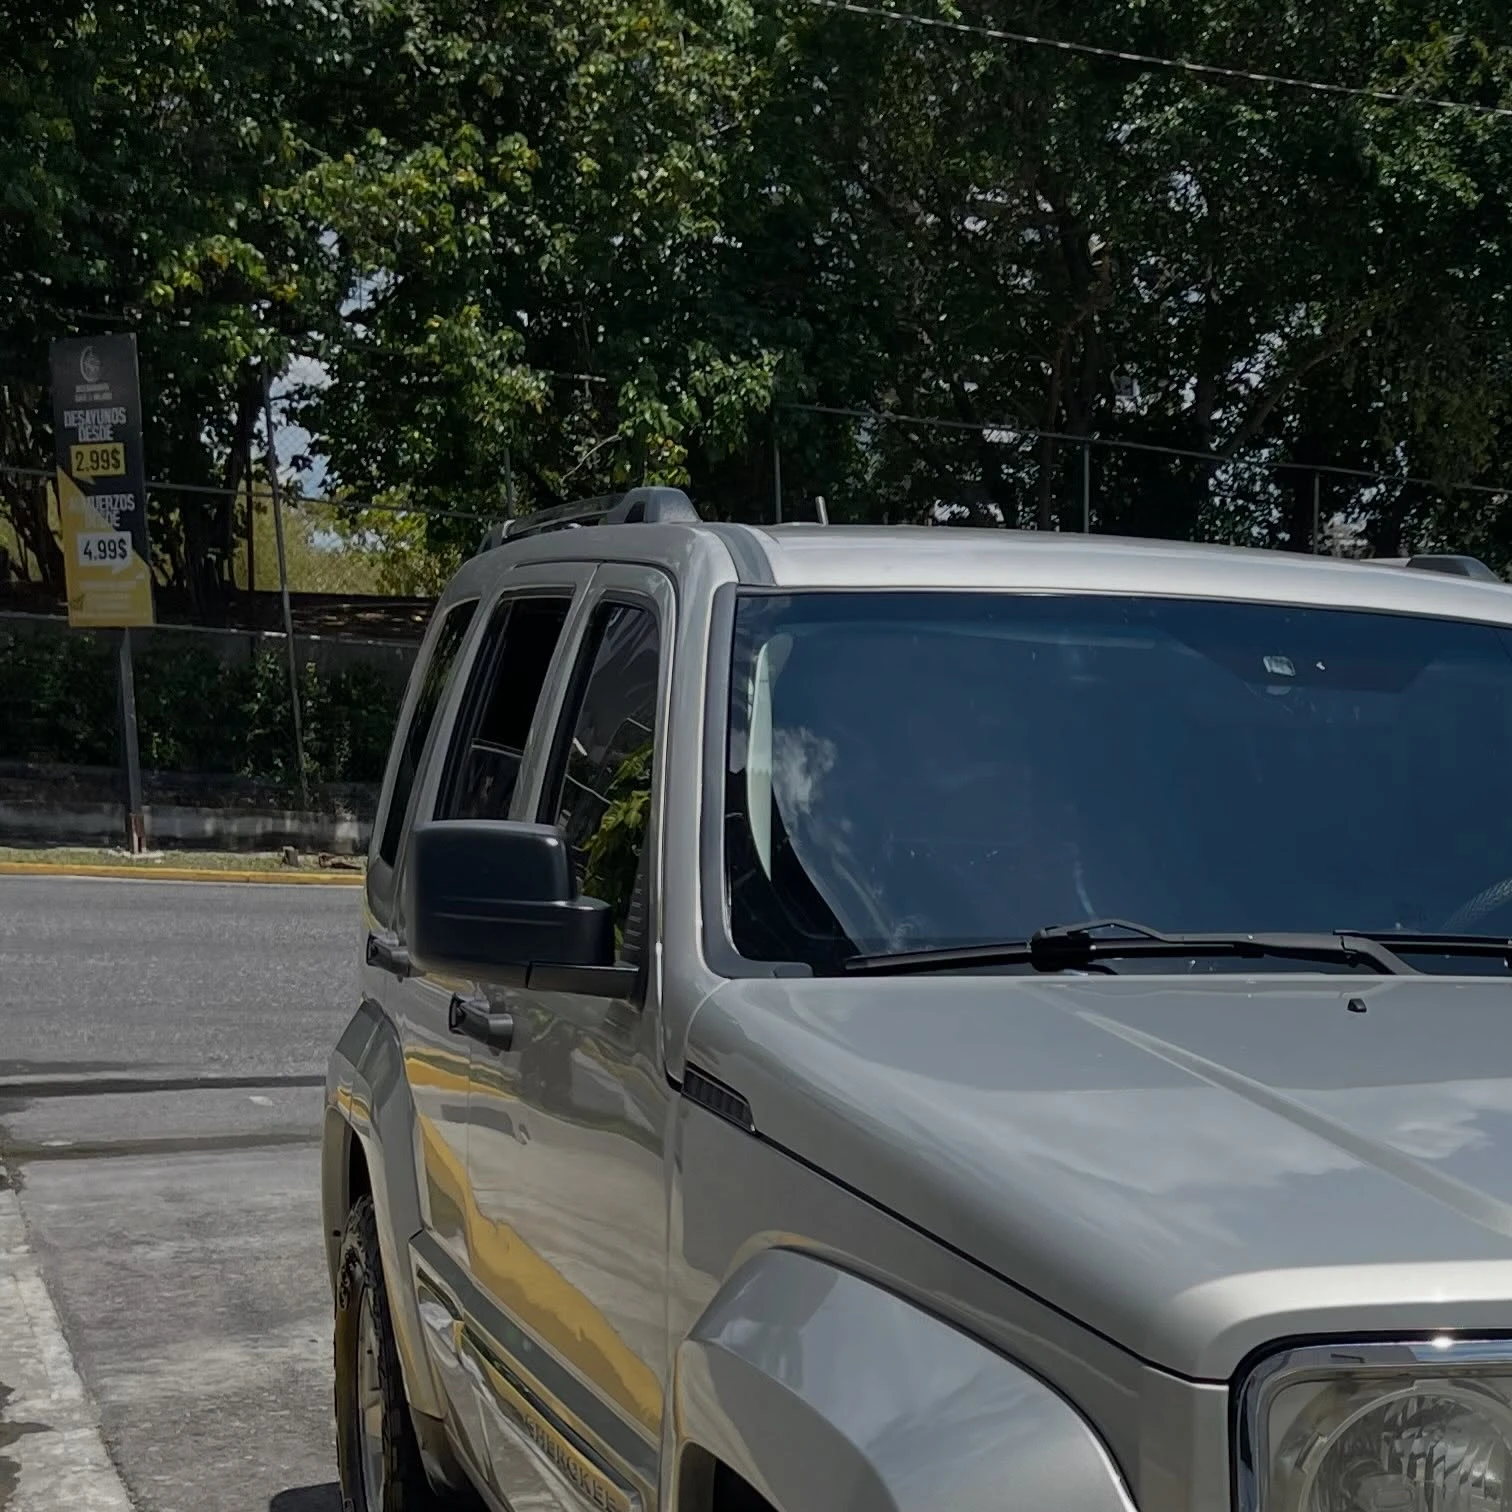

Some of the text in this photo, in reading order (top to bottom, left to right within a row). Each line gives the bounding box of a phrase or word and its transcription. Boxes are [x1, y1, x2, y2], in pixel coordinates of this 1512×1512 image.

[63, 407, 127, 428] DESAYUNOS
[78, 424, 115, 442] DESDE
[75, 448, 121, 472] 2.99$
[83, 538, 129, 561] 4.99$
